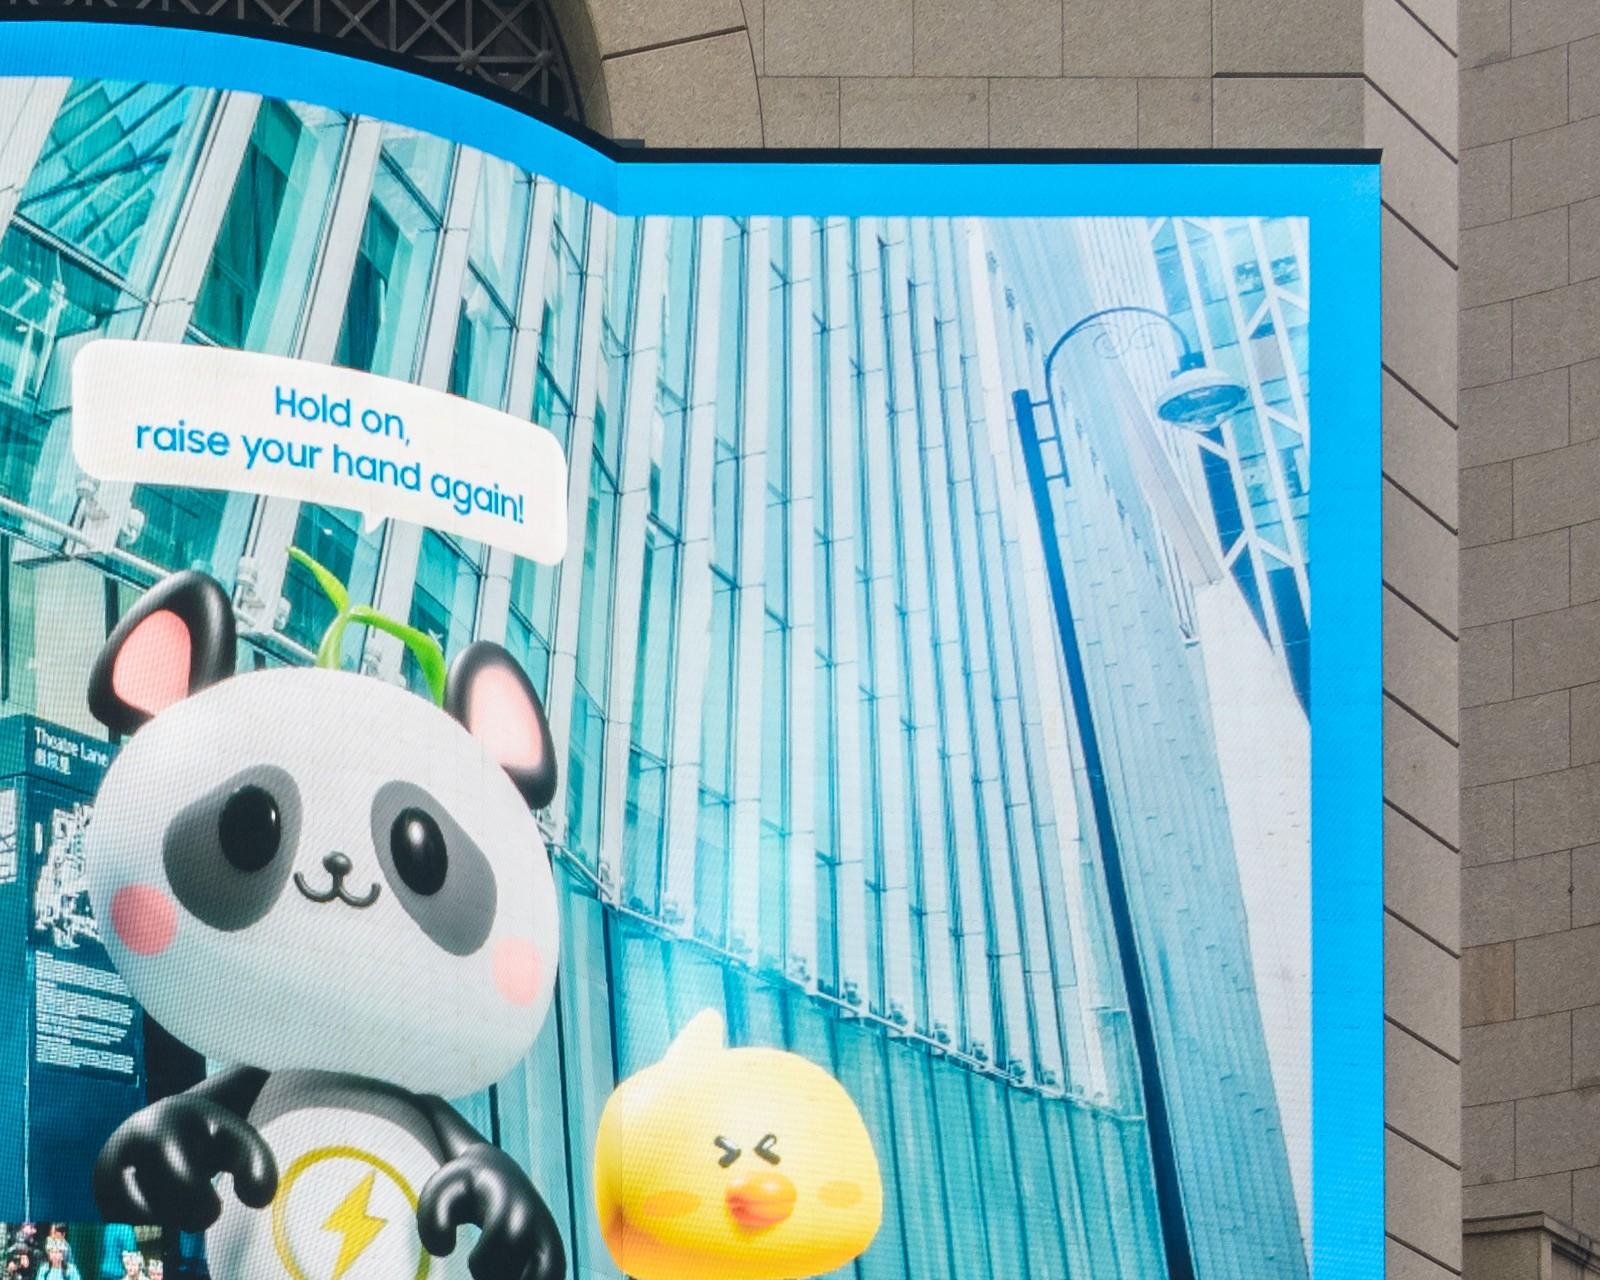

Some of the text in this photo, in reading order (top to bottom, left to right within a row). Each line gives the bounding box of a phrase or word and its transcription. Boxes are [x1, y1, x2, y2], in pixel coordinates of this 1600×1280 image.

[275, 386, 411, 447] Hold on,
[136, 420, 525, 525] raise your hand again!
